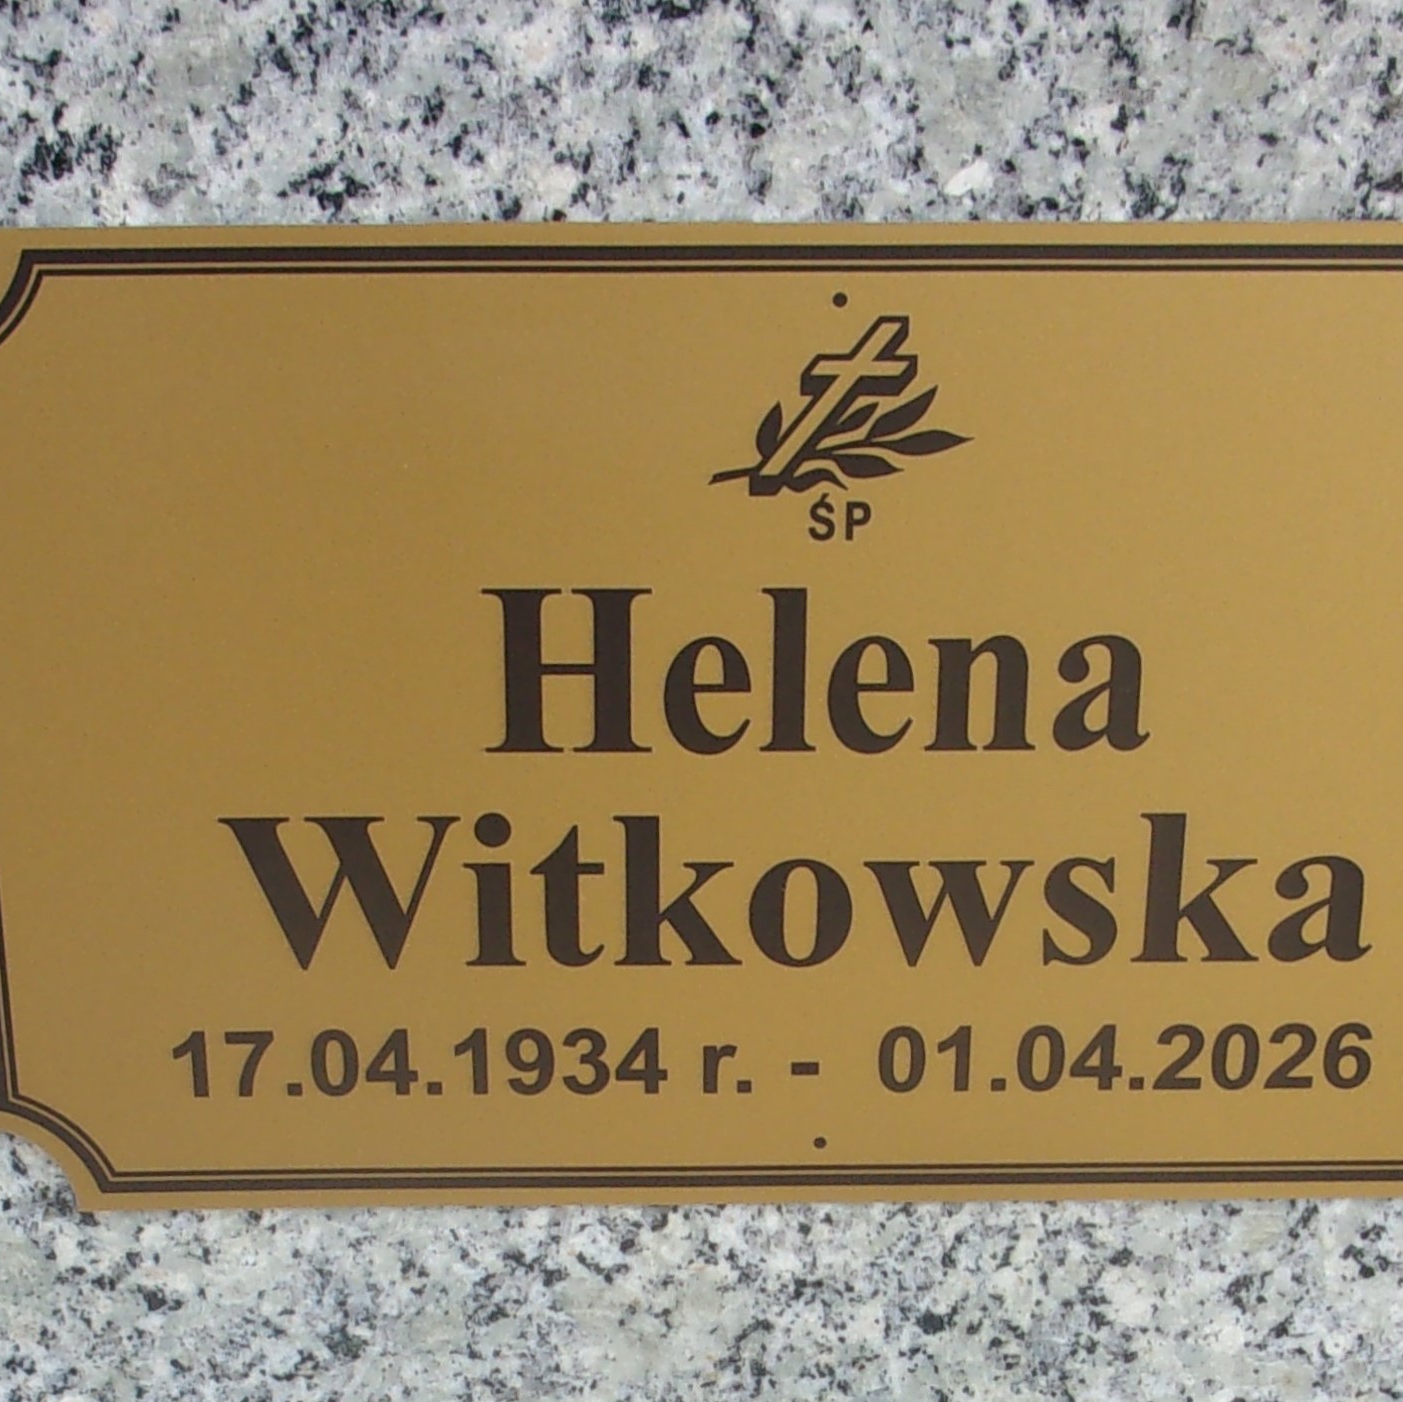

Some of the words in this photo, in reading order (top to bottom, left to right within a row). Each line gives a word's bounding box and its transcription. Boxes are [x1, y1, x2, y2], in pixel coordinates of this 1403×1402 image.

[808, 492, 872, 542] ŚP
[480, 586, 1151, 756] Helena
[216, 811, 1373, 972] Witkowska
[171, 1027, 669, 1098] 17.04.1934
[702, 1043, 753, 1095] r.
[790, 1061, 820, 1076] -
[877, 1022, 1373, 1094] 01.04.2026
